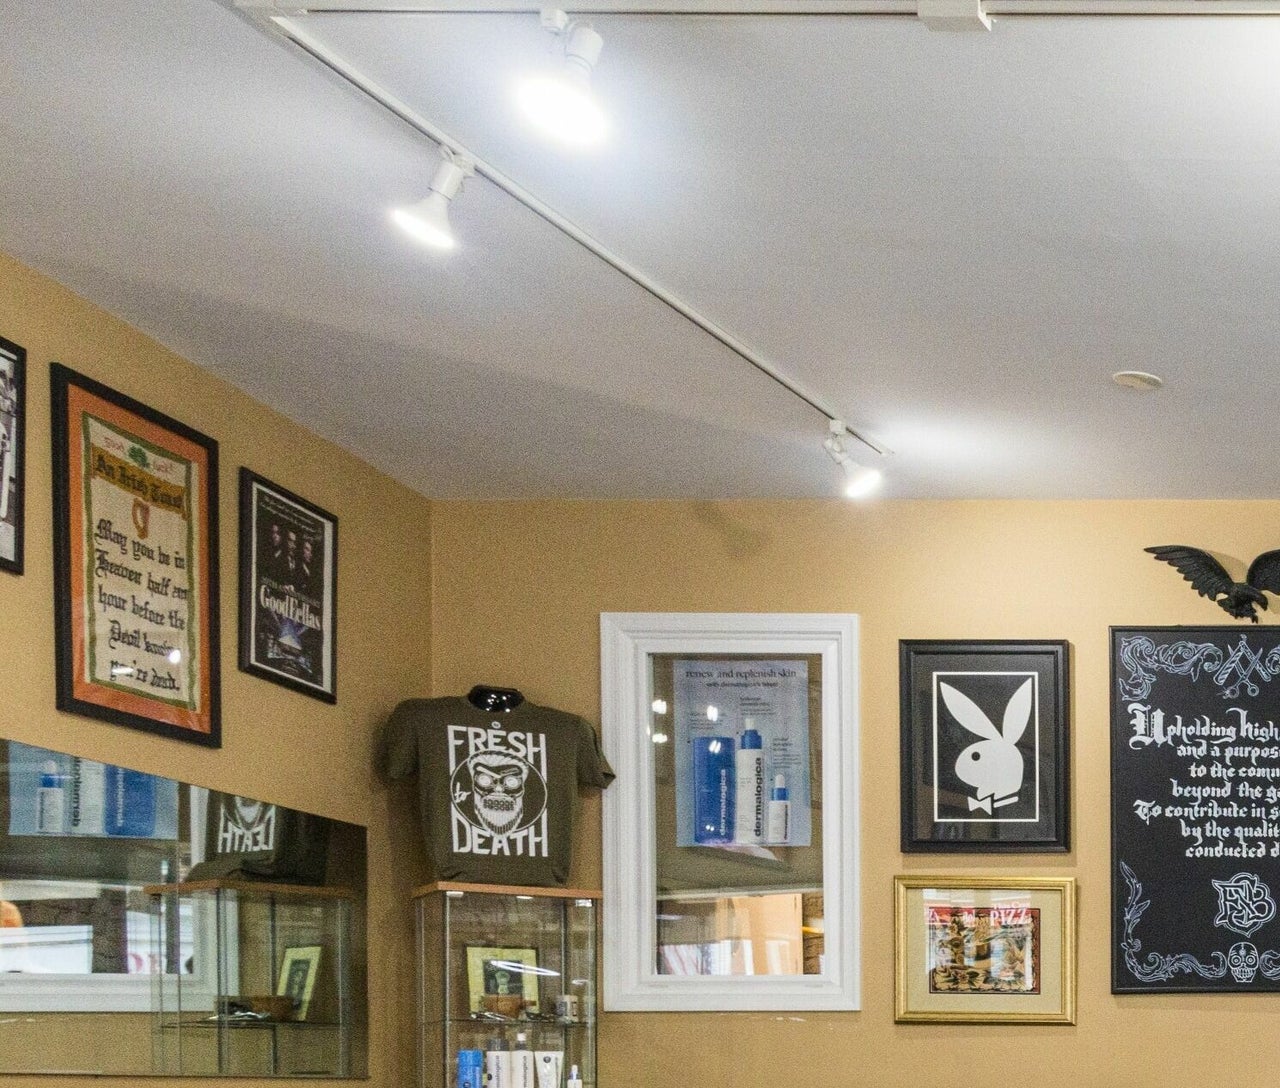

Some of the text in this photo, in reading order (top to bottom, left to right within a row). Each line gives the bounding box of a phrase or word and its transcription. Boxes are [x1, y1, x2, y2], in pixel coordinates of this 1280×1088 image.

[95, 518, 127, 555] May
[131, 539, 155, 561] you
[174, 551, 185, 569] in
[95, 549, 142, 585] Heaven
[131, 594, 165, 626] before
[168, 609, 185, 631] the
[260, 585, 321, 632] GoodFellas
[109, 618, 141, 649] Devil
[717, 669, 734, 678] and
[736, 669, 777, 680] replenish
[778, 669, 797, 678] skin
[1127, 702, 1237, 750] Upholding
[447, 725, 548, 783] FRESH
[1176, 740, 1207, 759] and
[1211, 745, 1221, 757] a
[1188, 763, 1207, 778] to
[1210, 761, 1236, 779] the
[719, 769, 727, 836] dermalogica
[753, 757, 764, 837] dermalogica
[1170, 778, 1232, 805] beyond
[1237, 781, 1262, 799] the
[450, 801, 548, 857] DEATH
[1133, 800, 1162, 825] To
[1164, 800, 1248, 821] contribute
[1251, 803, 1267, 819] in
[1179, 819, 1203, 846] by
[1204, 818, 1231, 839] the
[1185, 841, 1266, 859] conducted
